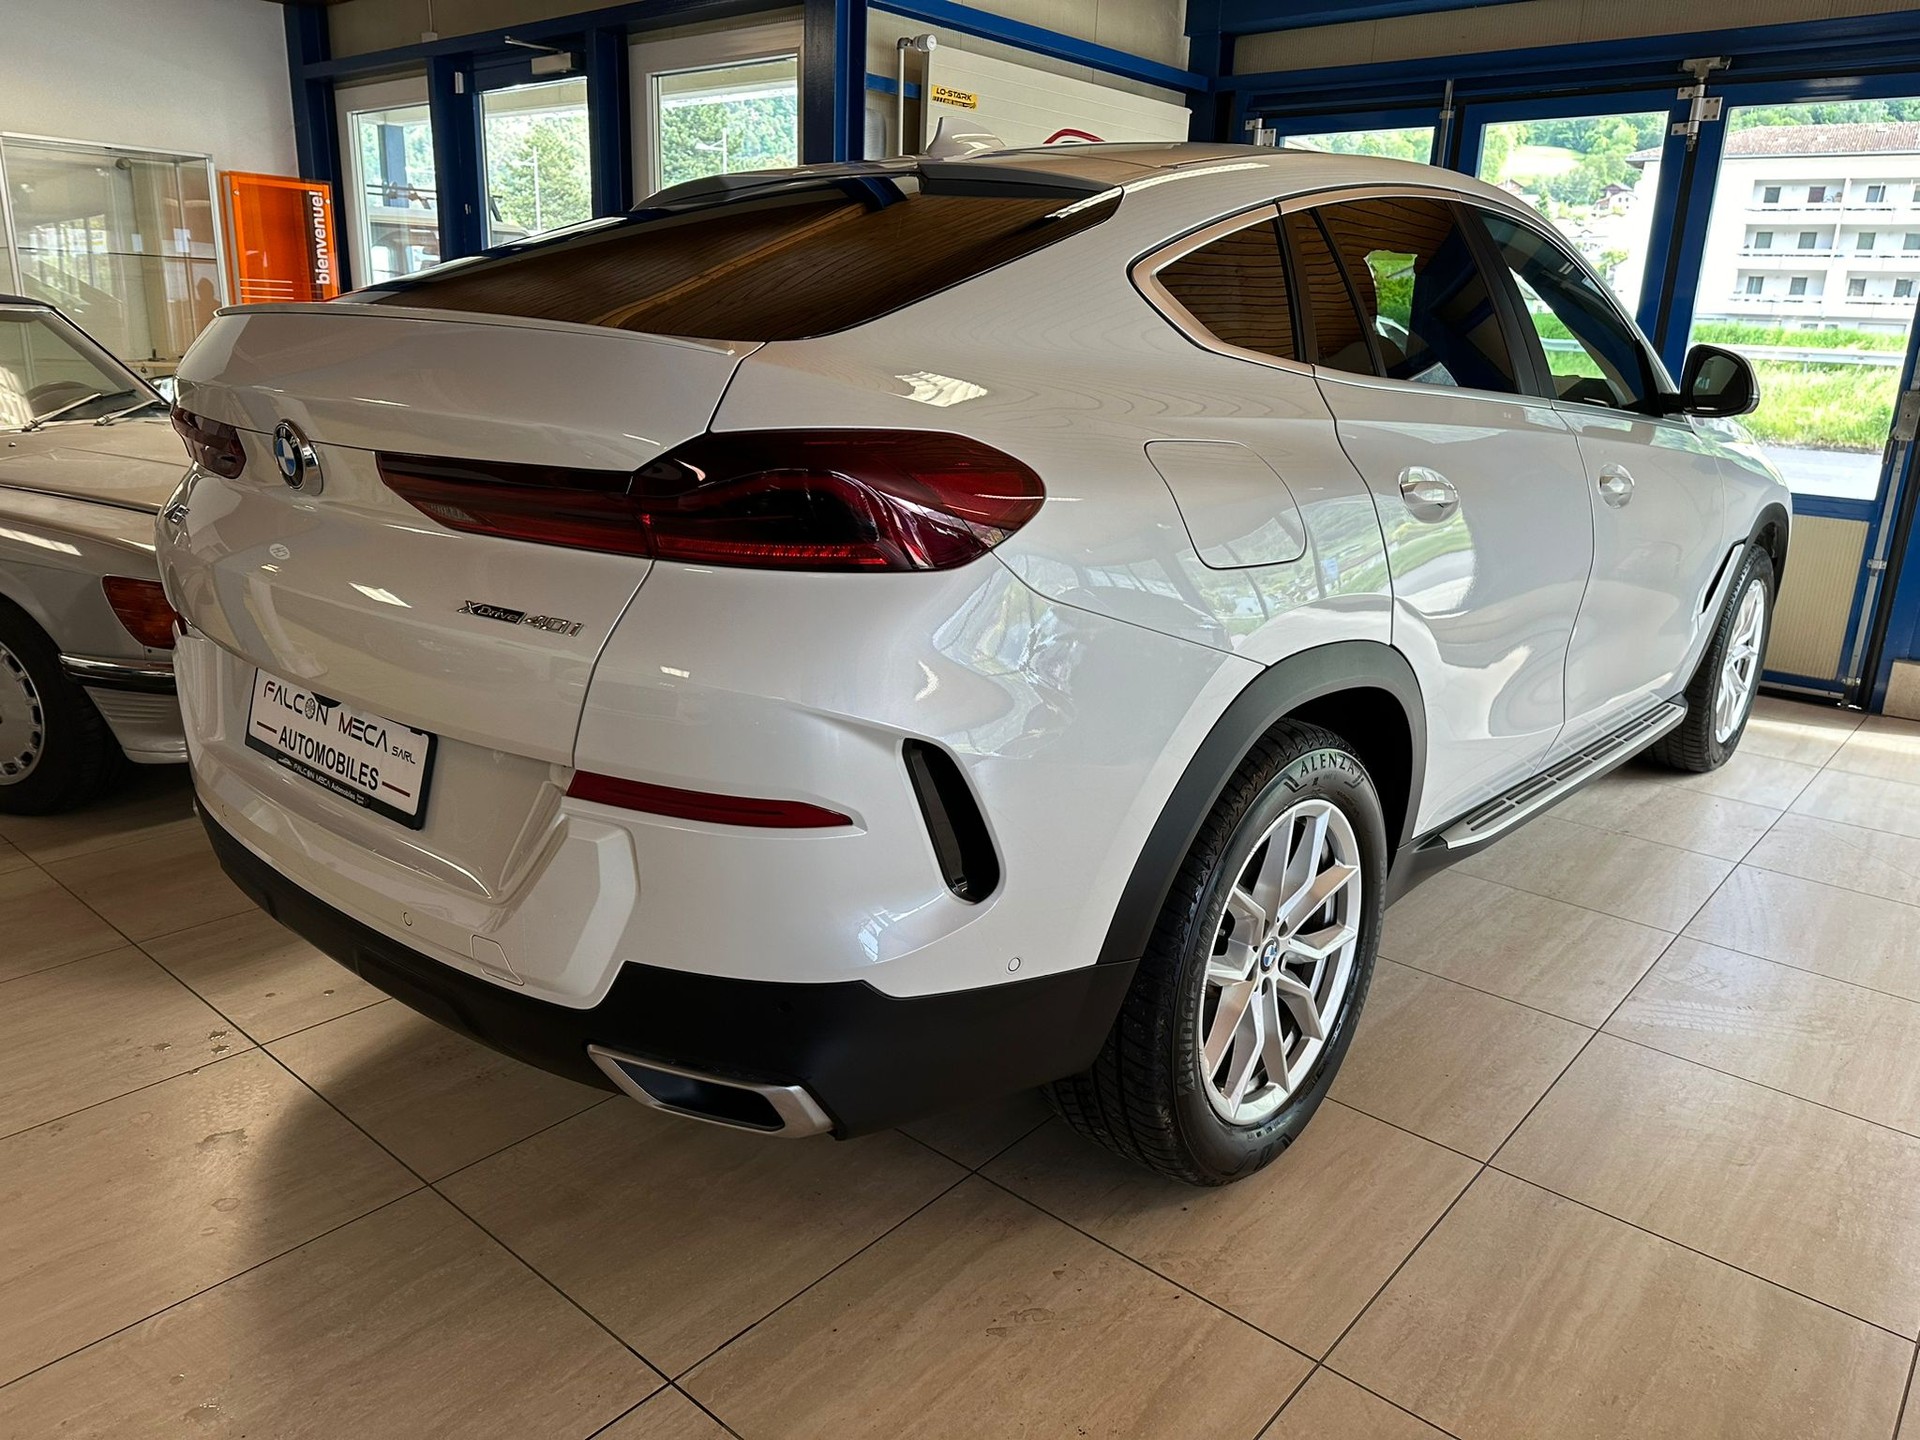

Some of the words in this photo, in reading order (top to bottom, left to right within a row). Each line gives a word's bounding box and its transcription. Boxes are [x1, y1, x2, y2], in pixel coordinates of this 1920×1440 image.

[309, 191, 330, 285] bienvenue!
[264, 680, 329, 726] FALCON
[338, 711, 388, 753] MECA
[391, 746, 416, 765] SARL
[278, 726, 379, 791] AUTOMOBILES
[1300, 753, 1355, 778] ALENZA
